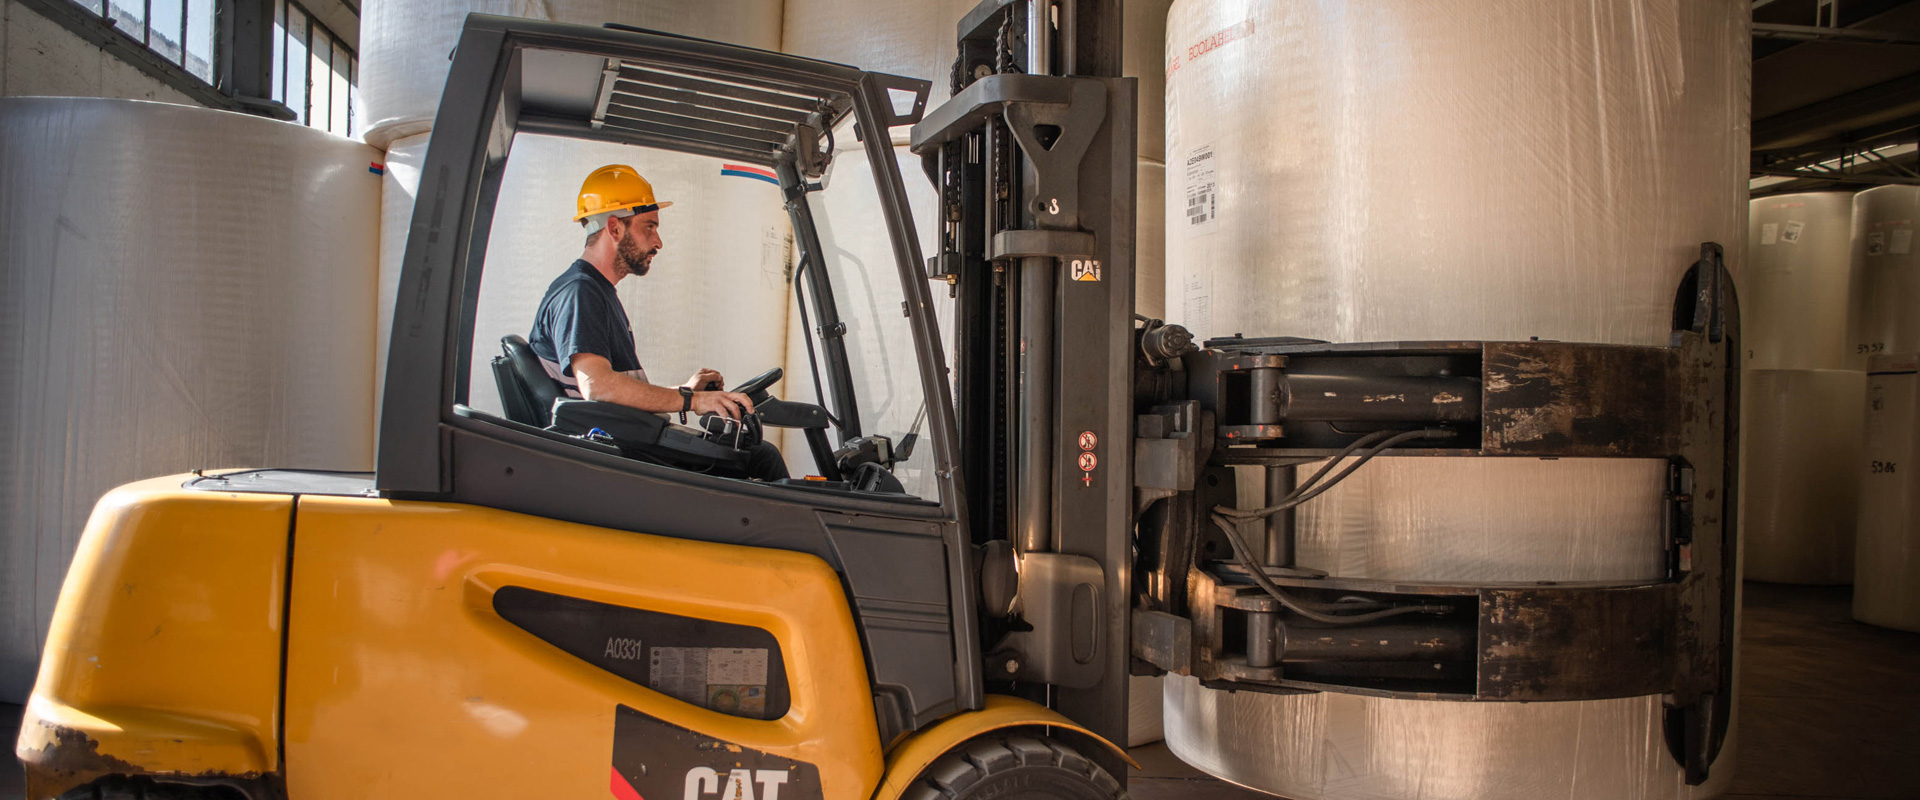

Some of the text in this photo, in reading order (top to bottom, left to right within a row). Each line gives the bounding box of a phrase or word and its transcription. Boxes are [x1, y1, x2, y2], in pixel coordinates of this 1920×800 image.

[1188, 27, 1235, 61] ECOLABEL
[1071, 259, 1101, 281] CAT
[604, 637, 642, 661] A0331
[684, 766, 788, 800] CAT
